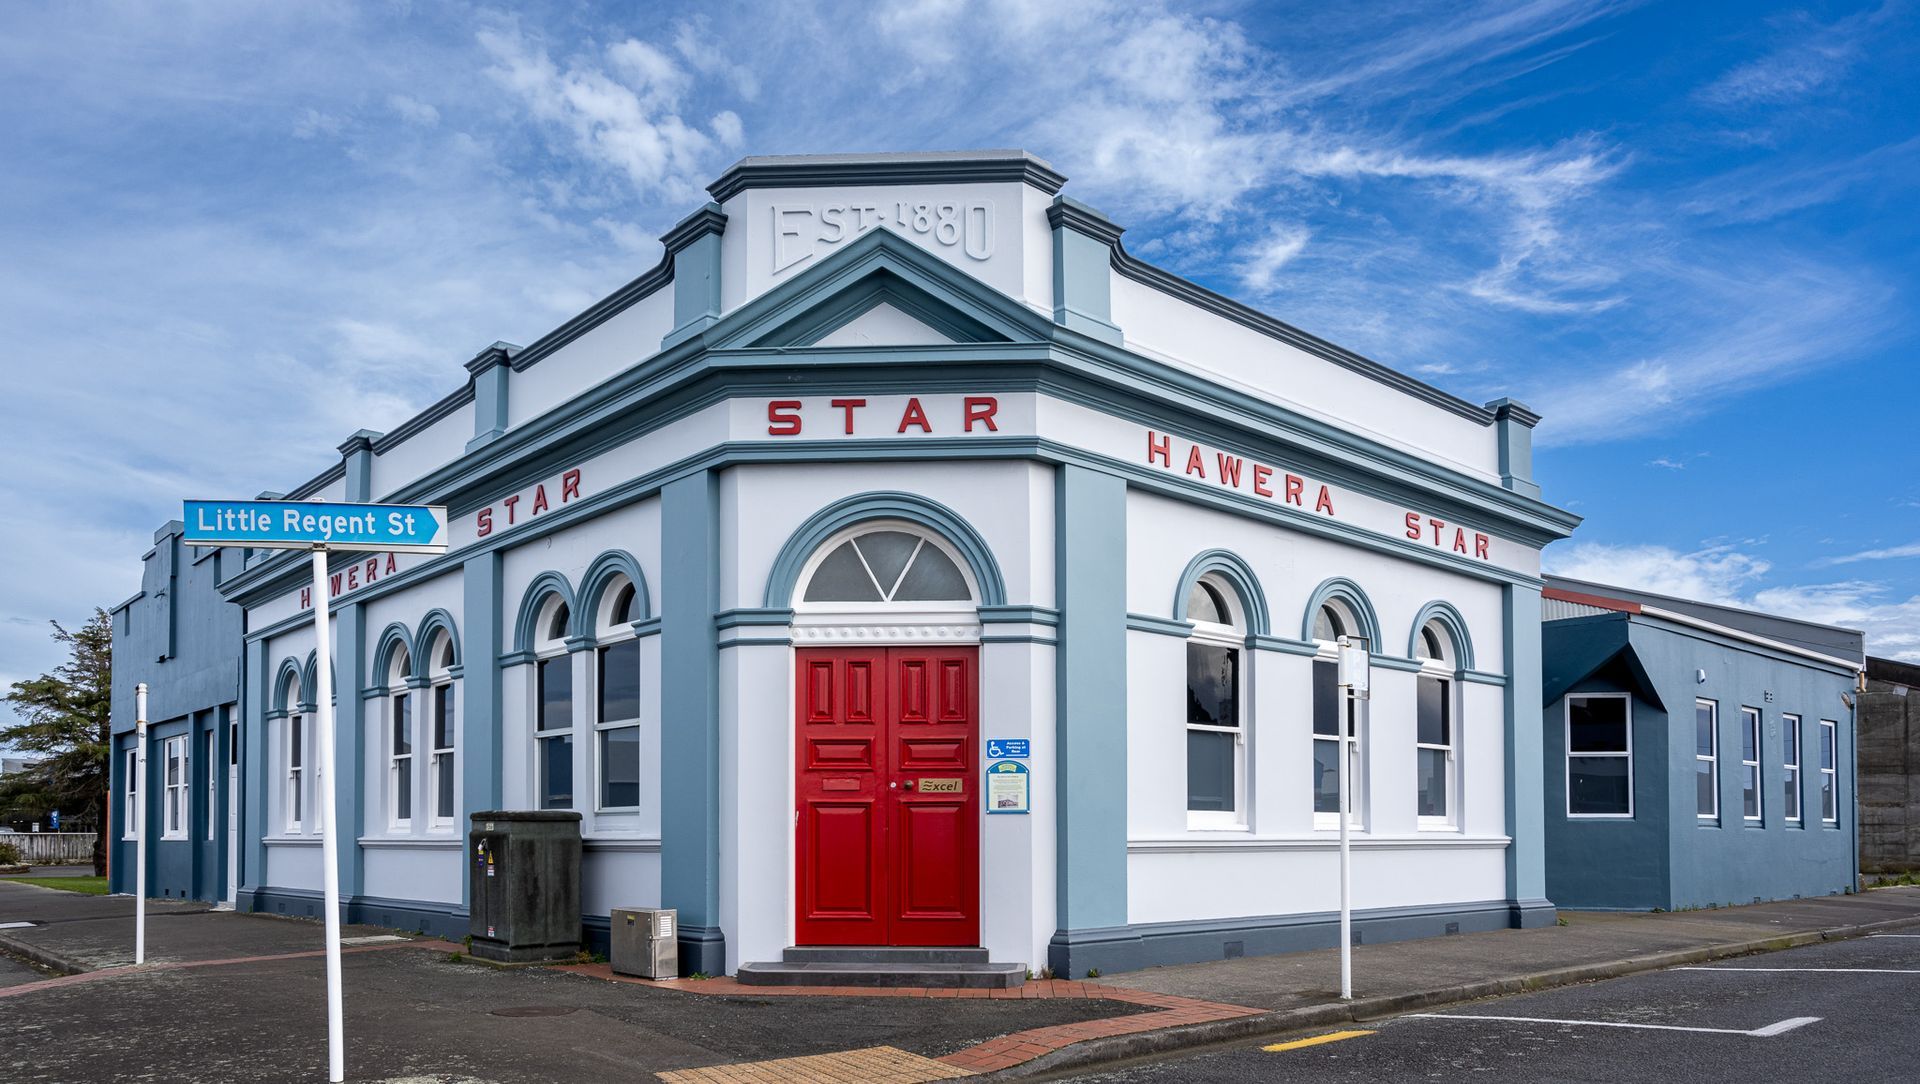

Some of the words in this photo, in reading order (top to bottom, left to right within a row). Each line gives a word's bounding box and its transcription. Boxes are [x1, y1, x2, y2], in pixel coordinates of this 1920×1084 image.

[896, 200, 995, 261] 1880
[768, 397, 998, 435] STAR
[1148, 431, 1335, 516] HAWERA
[1405, 512, 1489, 560] STAR
[198, 508, 272, 532] Little
[283, 509, 376, 541] Regent
[388, 512, 416, 536] St
[301, 552, 396, 609] HWERA
[477, 468, 580, 537] STAR
[922, 780, 957, 791] Excel
